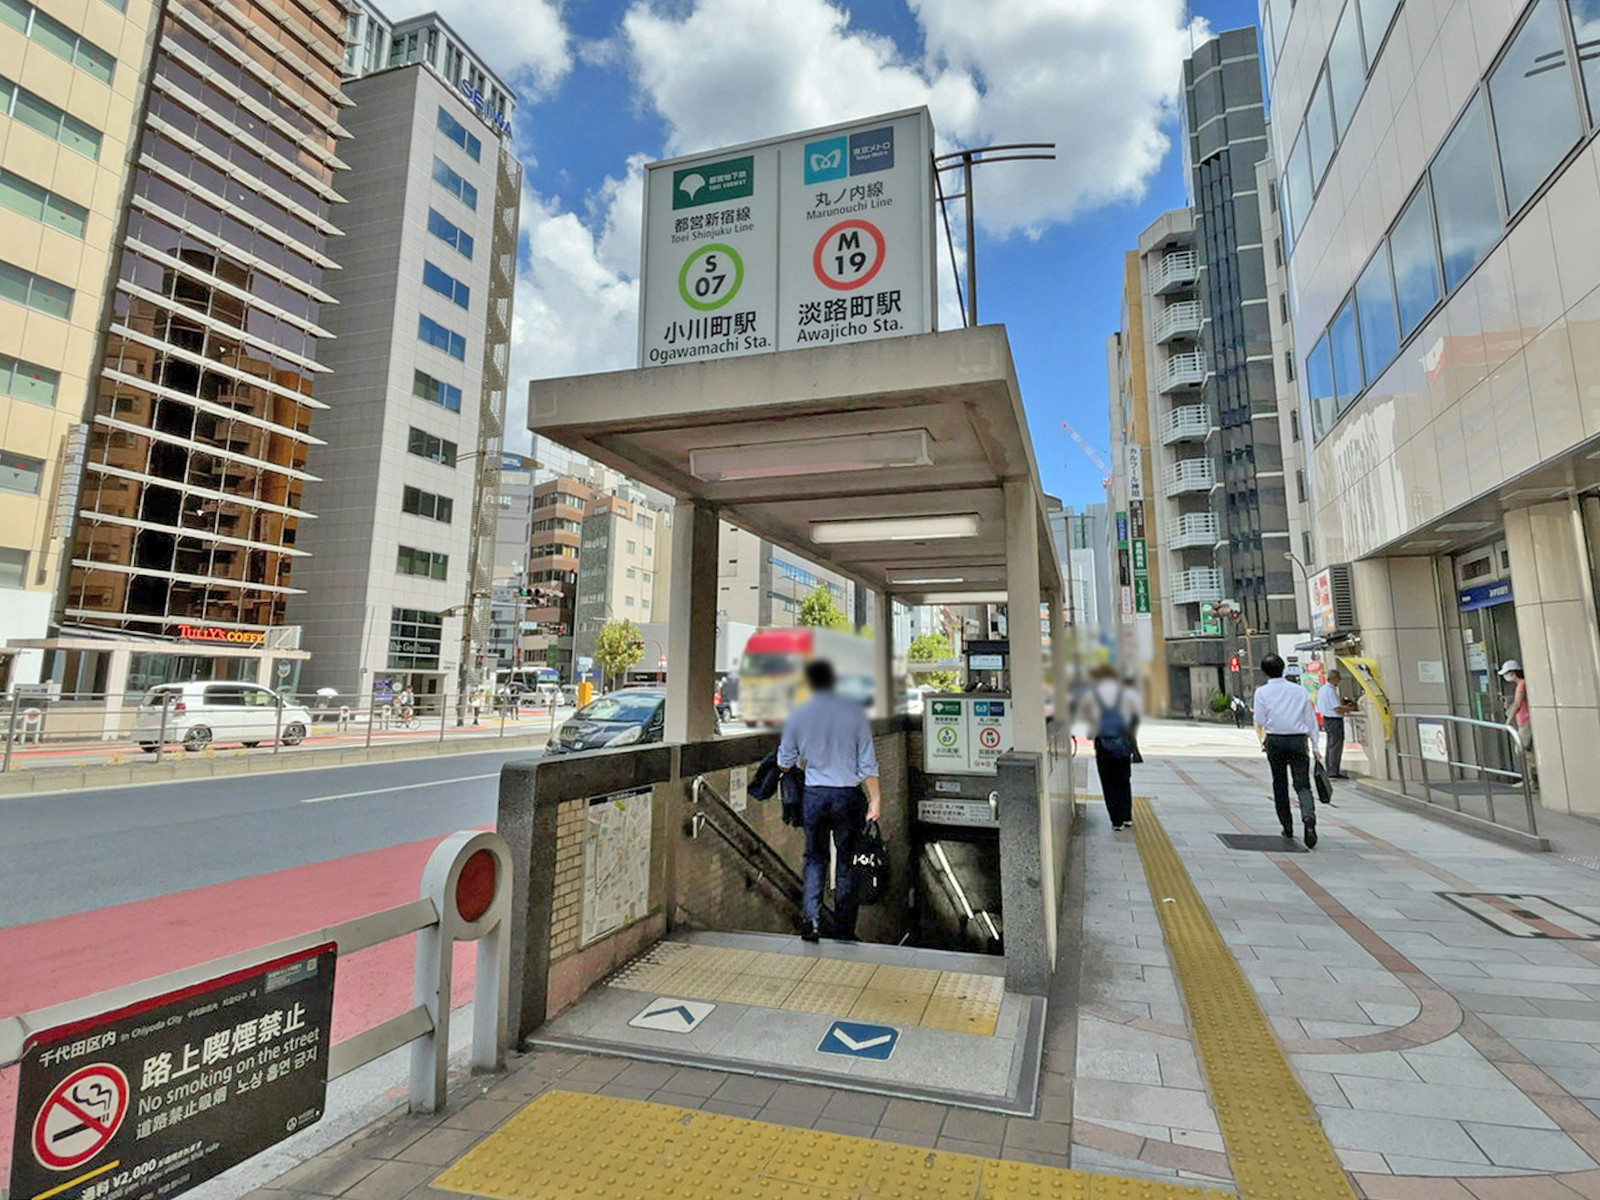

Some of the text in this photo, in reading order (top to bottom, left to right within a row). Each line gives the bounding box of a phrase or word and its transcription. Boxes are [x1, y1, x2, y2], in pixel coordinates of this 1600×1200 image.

[815, 181, 884, 208] 丸ノ内線
[675, 206, 751, 233] 都営新宿線
[806, 197, 893, 220] Marunouchi Line
[671, 222, 754, 244] Toei Shinjuku Line
[838, 231, 860, 251] M
[705, 255, 717, 273] S
[835, 252, 866, 275] 19
[695, 274, 726, 297] 07
[798, 290, 901, 326] 淡路町駅
[664, 311, 756, 344] 小川町駅
[797, 318, 903, 342] Awajicho Sta.
[649, 336, 771, 364] Ogawamachi Sta.
[178, 624, 226, 641] TULLY'S
[39, 1030, 117, 1067] 千代田区内
[140, 1002, 306, 1092] 路上喫煙禁止
[138, 1027, 319, 1116] No smoking on the street
[236, 1070, 263, 1094] 노상
[294, 1045, 318, 1069] 금지
[113, 1158, 157, 1188] ¥2,000
